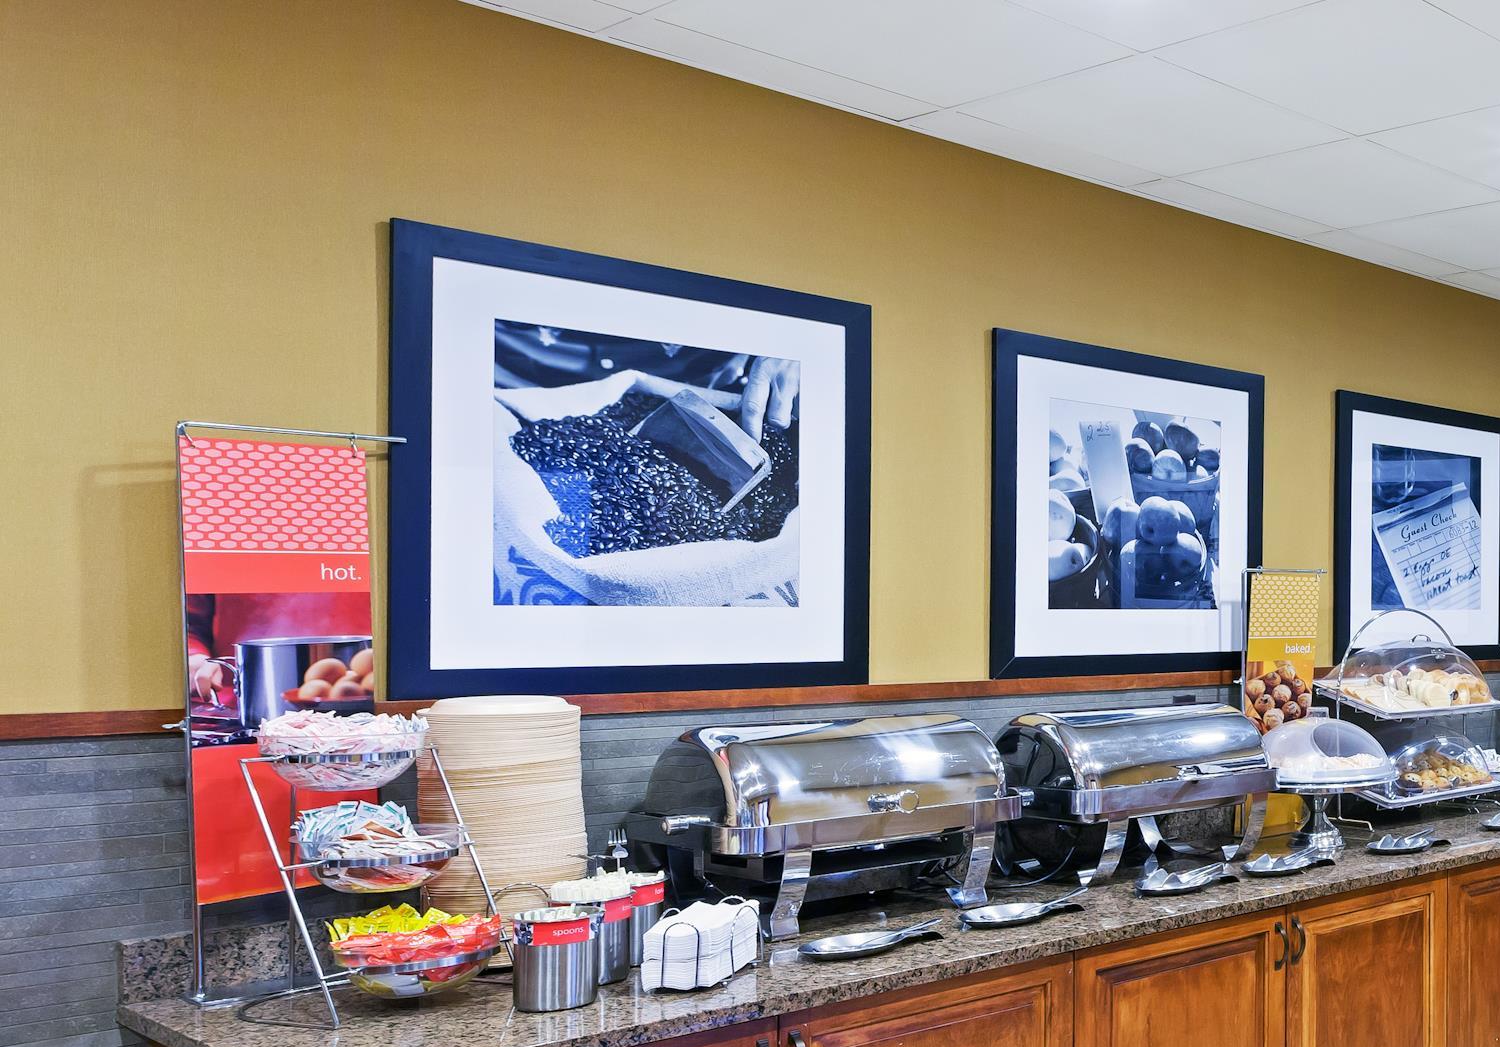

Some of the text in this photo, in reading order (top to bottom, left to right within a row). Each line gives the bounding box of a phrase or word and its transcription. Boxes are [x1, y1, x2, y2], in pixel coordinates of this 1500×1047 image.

[1401, 523, 1428, 543] Guest
[1431, 508, 1457, 527] Check
[320, 562, 362, 581] hot.
[1285, 643, 1312, 654] baked.
[552, 926, 584, 937] spoons
